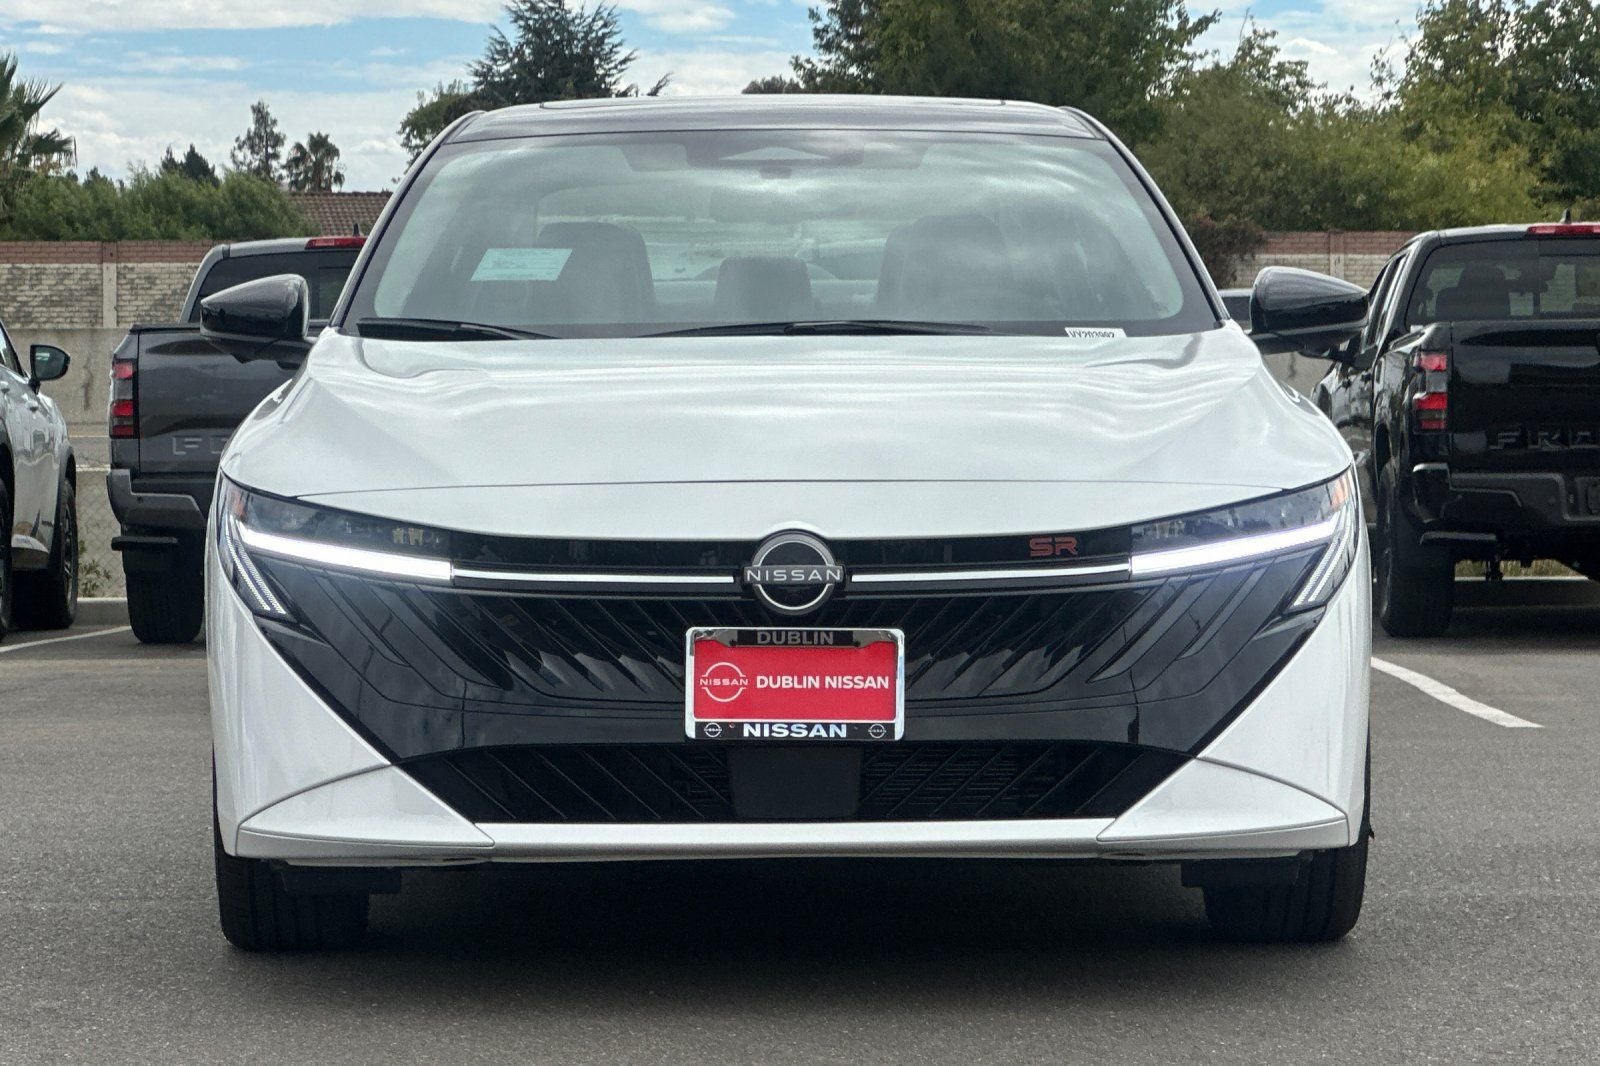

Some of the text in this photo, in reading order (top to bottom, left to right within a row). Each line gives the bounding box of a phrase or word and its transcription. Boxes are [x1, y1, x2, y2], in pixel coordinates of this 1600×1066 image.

[1029, 536, 1078, 557] SR
[746, 569, 843, 582] NISSAN
[756, 630, 834, 645] DUBLIN
[699, 677, 749, 687] NISSAN
[756, 675, 889, 689] DUBLIN NISSAN
[743, 723, 847, 738] NISSAN
